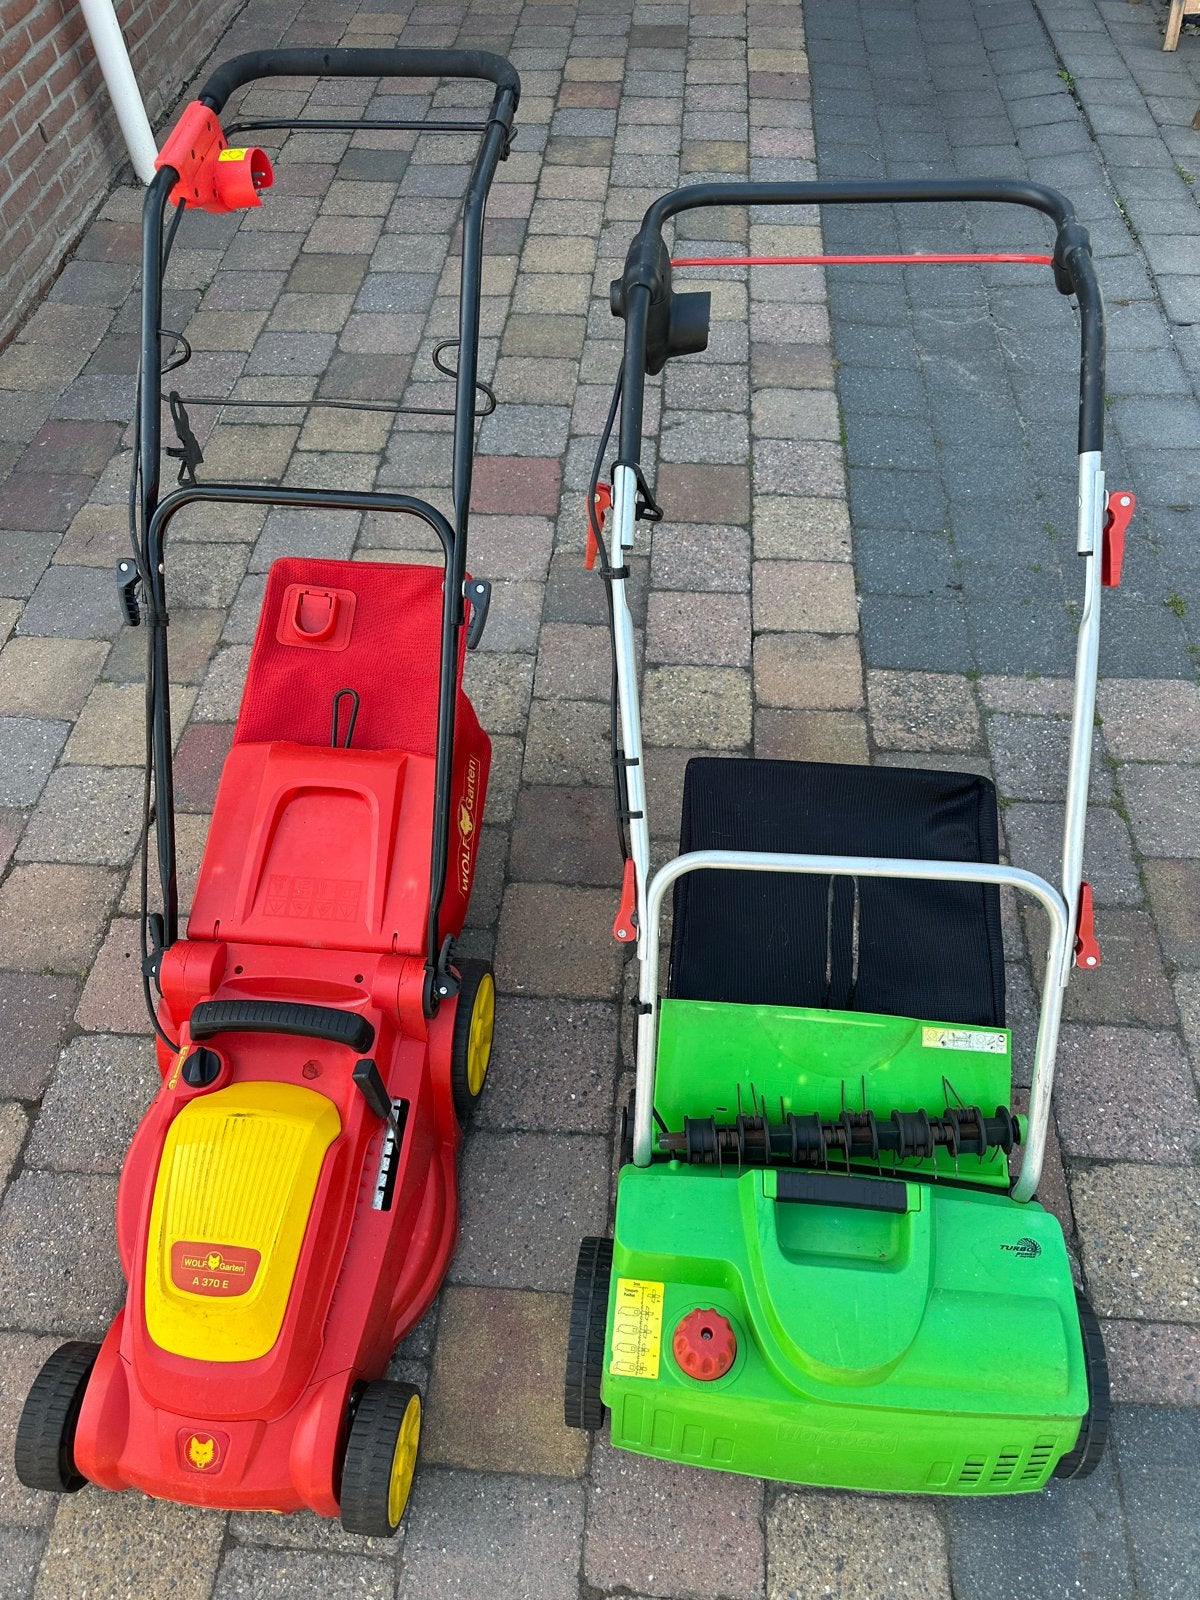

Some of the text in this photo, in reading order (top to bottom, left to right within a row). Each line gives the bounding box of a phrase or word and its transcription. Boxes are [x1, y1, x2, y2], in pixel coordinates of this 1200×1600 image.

[461, 758, 477, 892] WOLF Garten
[184, 1258, 244, 1273] WOLF Garten
[192, 1276, 230, 1289] A 370 E
